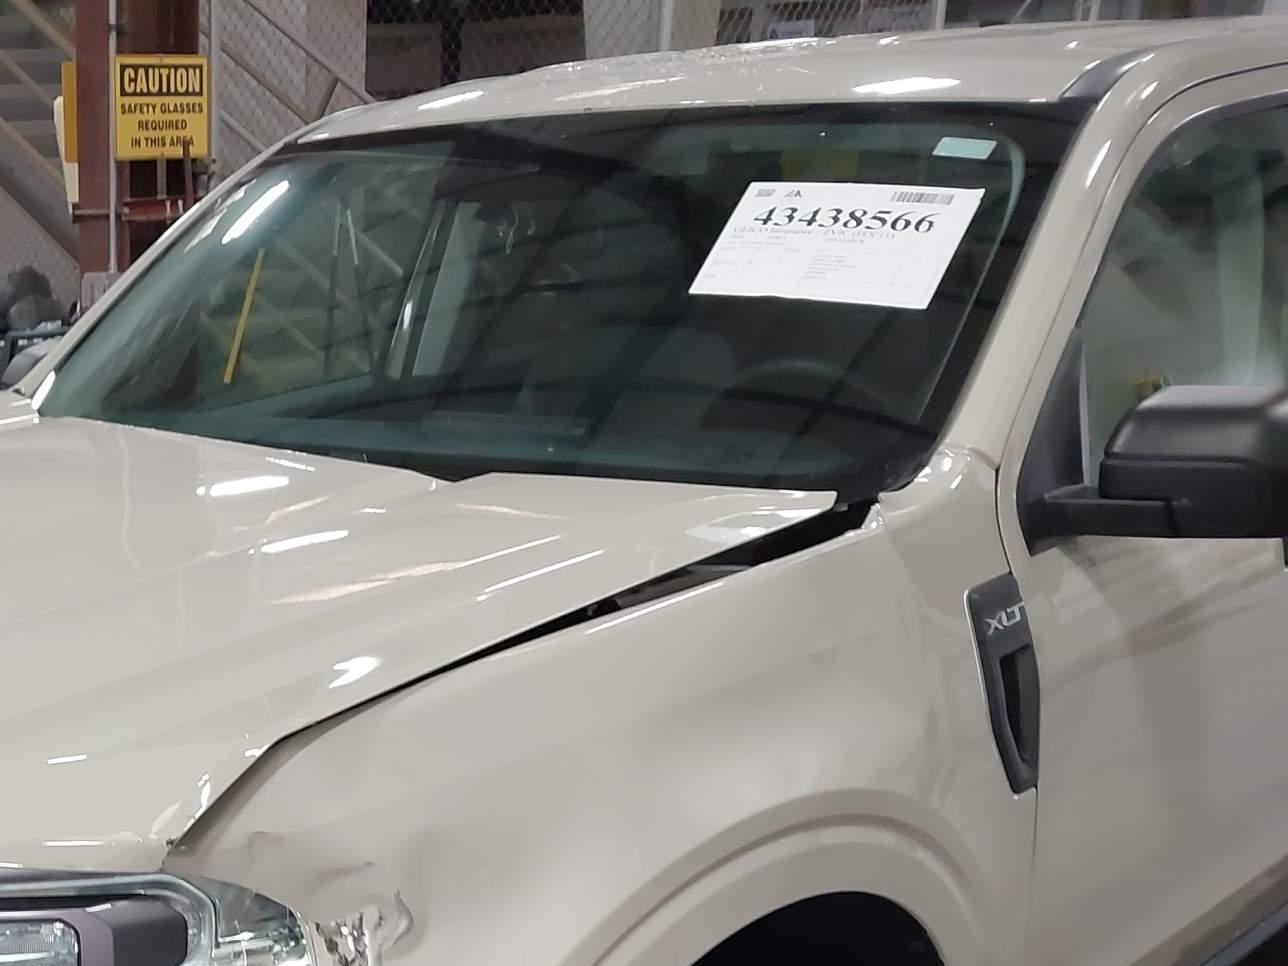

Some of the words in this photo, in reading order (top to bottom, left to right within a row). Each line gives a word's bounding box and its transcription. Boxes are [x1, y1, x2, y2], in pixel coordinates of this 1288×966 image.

[123, 67, 200, 94] CAUTION
[120, 103, 157, 115] SAFETY
[160, 102, 203, 114] GLASSES
[137, 119, 187, 131] REQUIRED
[131, 136, 141, 148] IN
[144, 136, 166, 148] THIS
[753, 206, 942, 233] 43438566
[983, 601, 1024, 636] XLT
